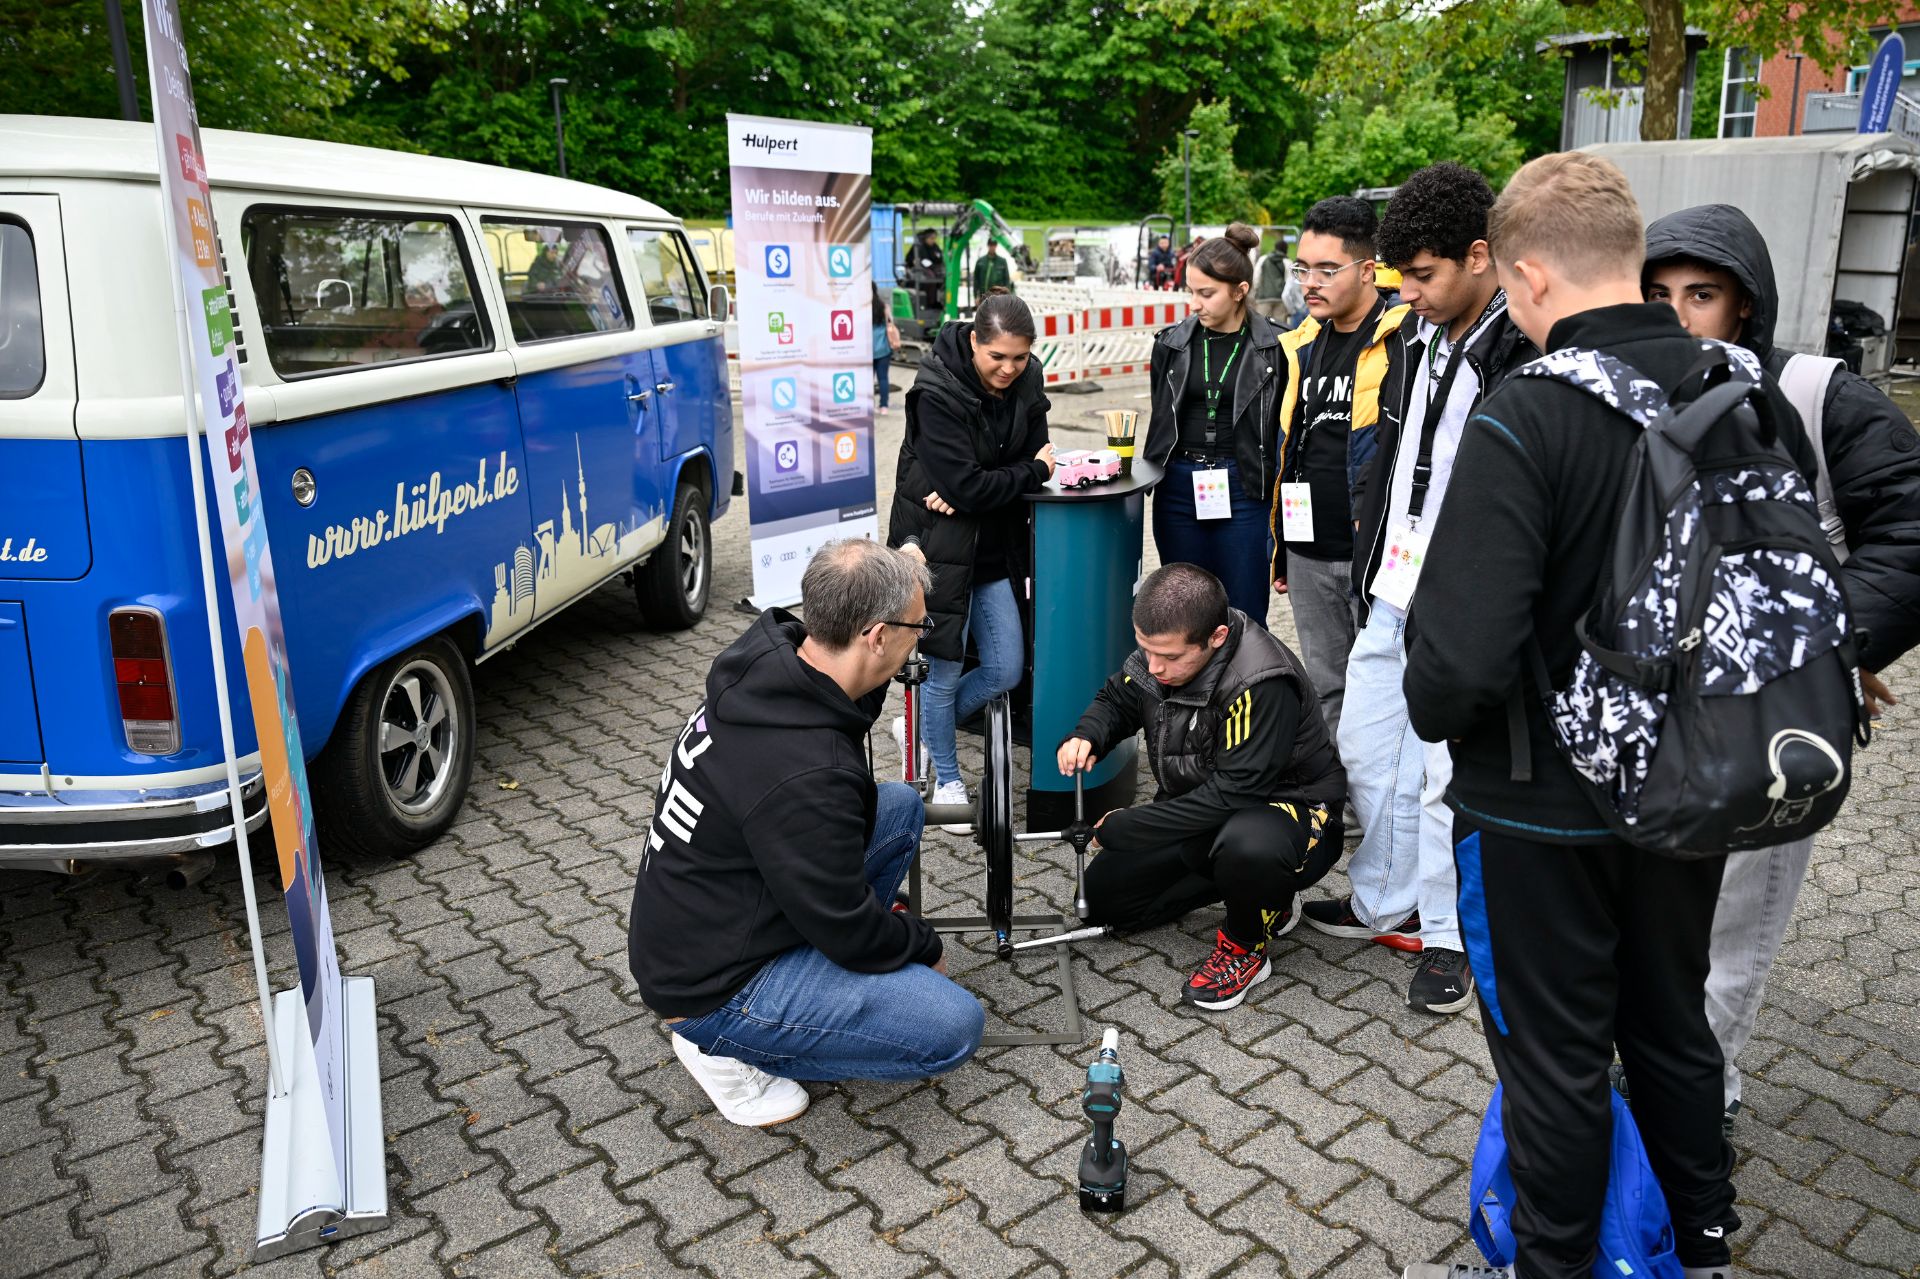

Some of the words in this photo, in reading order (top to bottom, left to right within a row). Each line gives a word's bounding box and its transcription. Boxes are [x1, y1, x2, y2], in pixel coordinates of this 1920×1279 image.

[1867, 54, 1890, 130] Performance
[1875, 69, 1893, 123] Business
[744, 188, 770, 205] Wir
[772, 190, 813, 208] bilden
[814, 194, 841, 208] aus.
[744, 211, 775, 223] Berufe
[776, 212, 791, 223] mit
[792, 212, 826, 224] Zukunft.
[307, 451, 519, 569] www.hülpert.de
[0, 538, 48, 562] t.de
